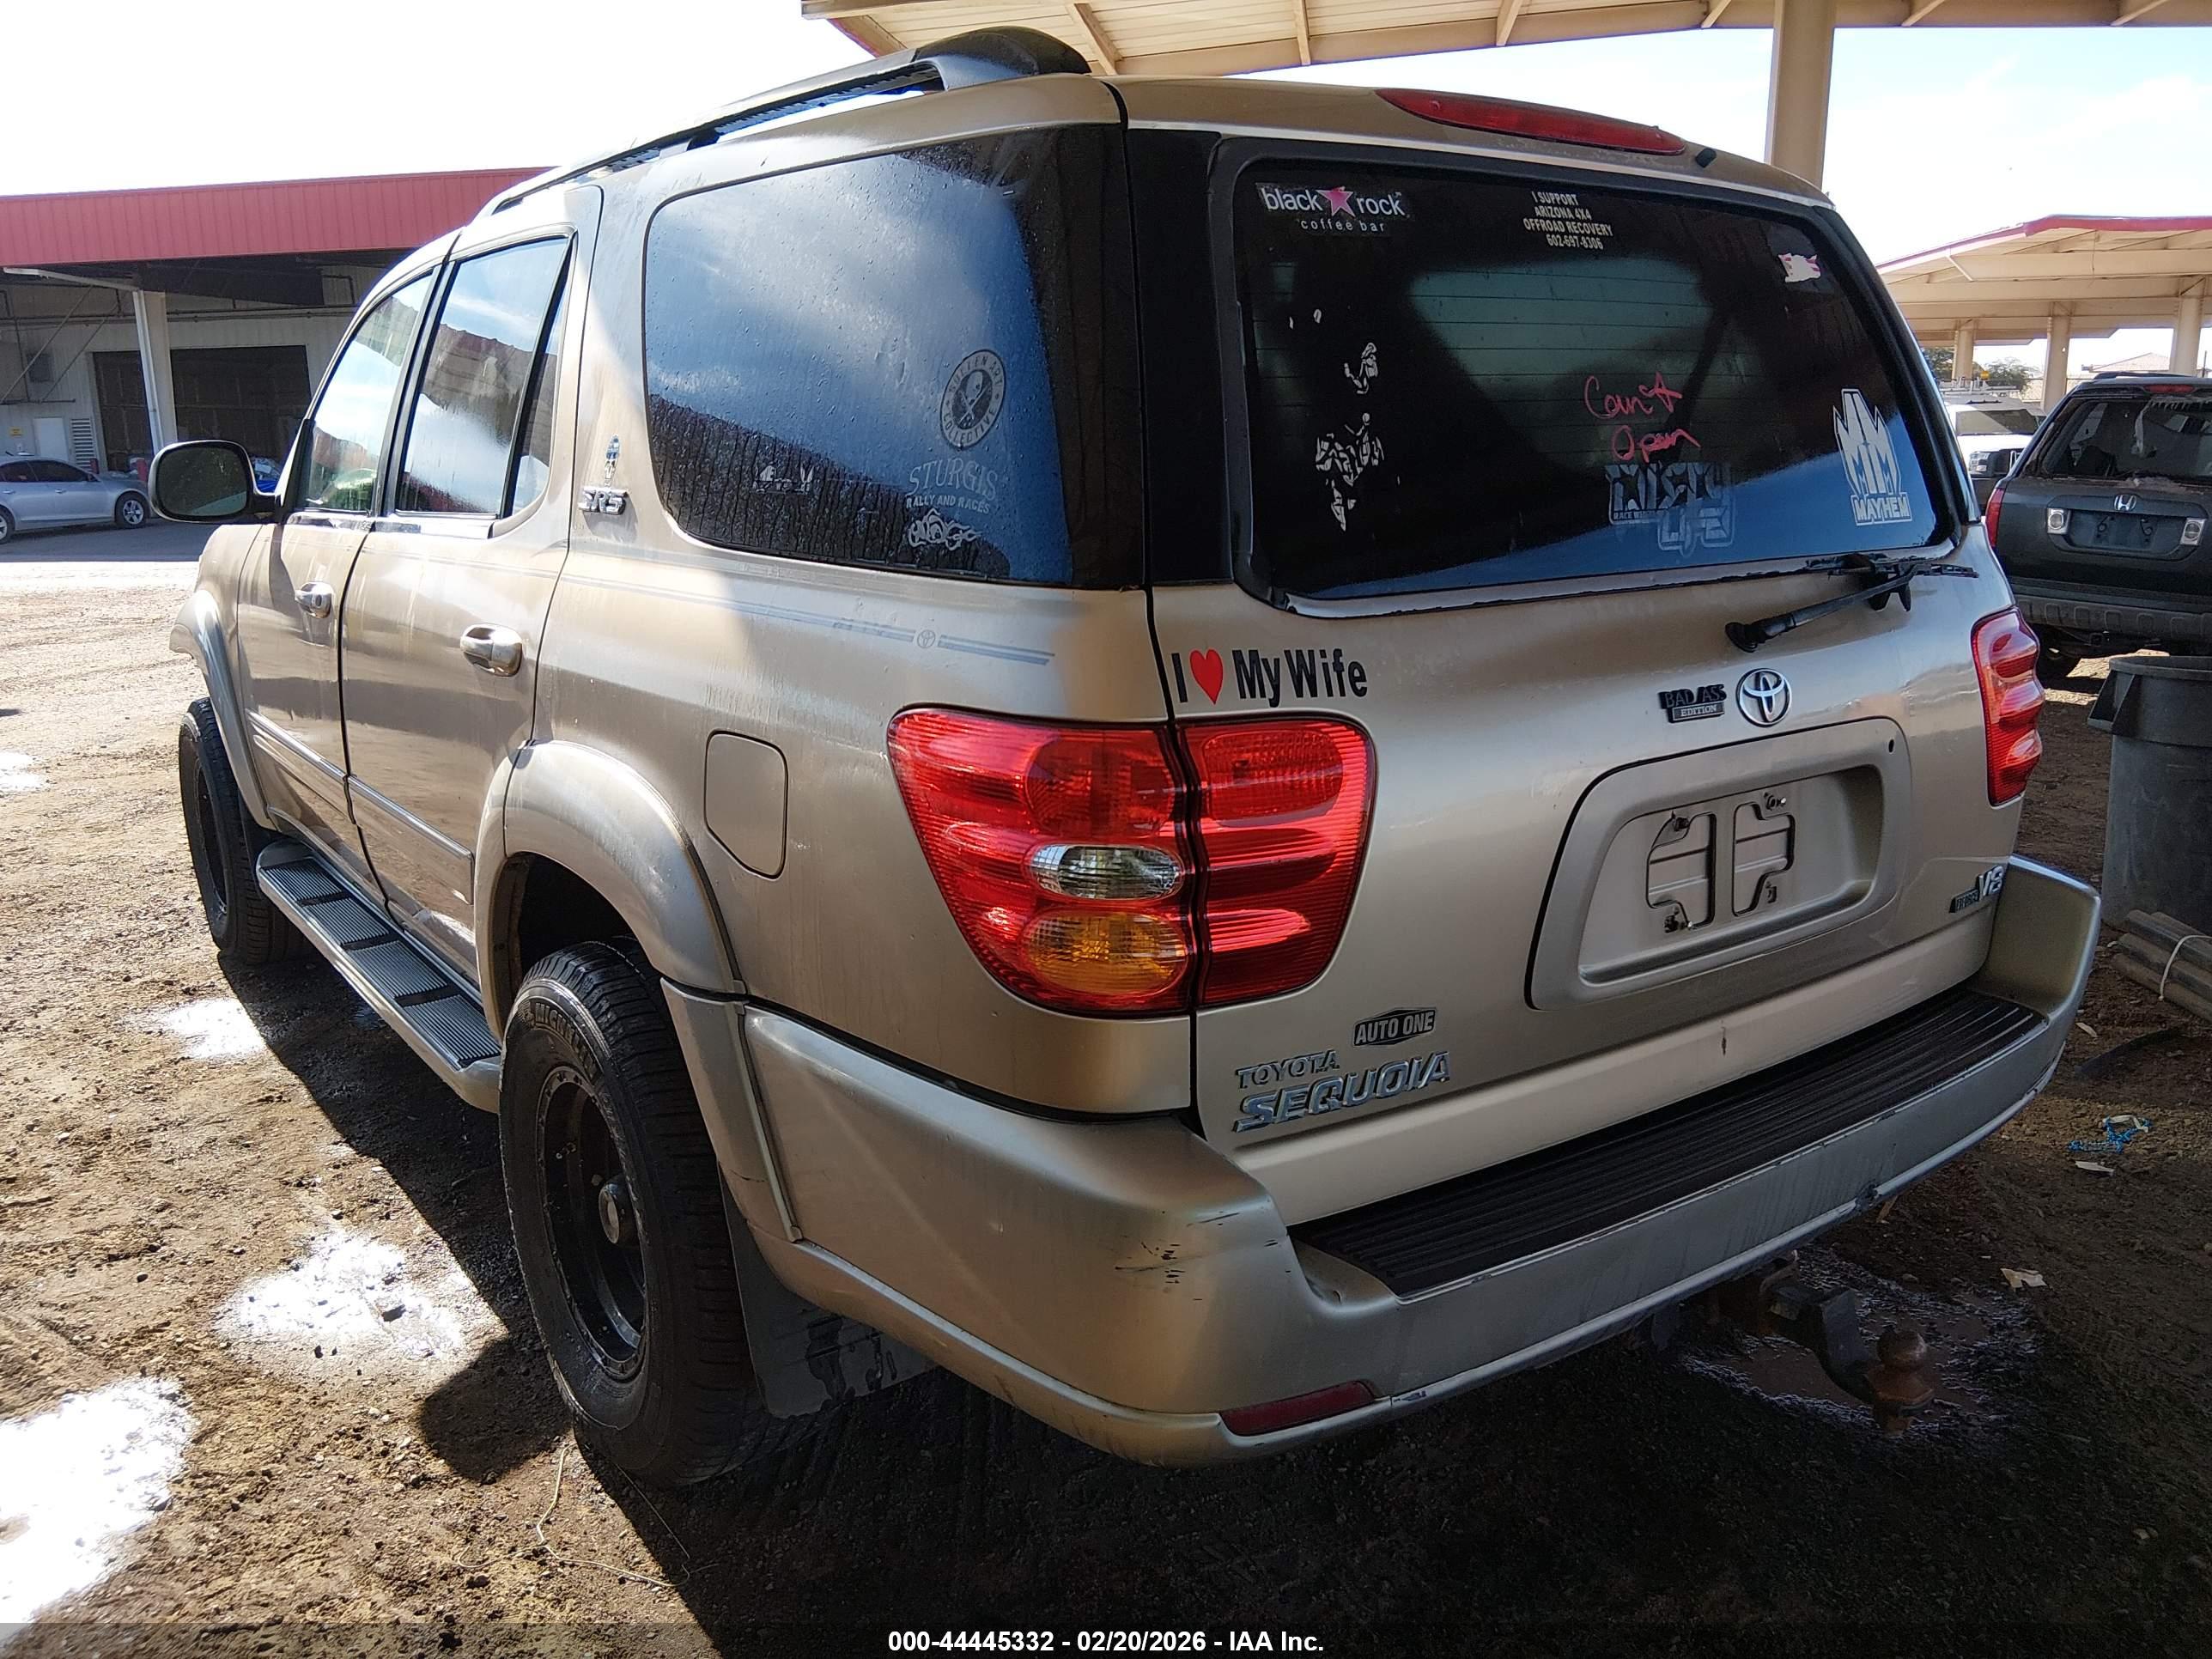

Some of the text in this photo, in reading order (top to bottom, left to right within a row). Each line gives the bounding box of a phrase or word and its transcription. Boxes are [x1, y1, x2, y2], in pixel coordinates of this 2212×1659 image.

[1261, 187, 1405, 216] black rock
[1531, 191, 1579, 206] I SUPPORT
[1534, 205, 1592, 221] ARIZONA 4X4
[1300, 218, 1385, 233] coffee bar
[1522, 217, 1613, 237] OFFROAD RECOVERY
[943, 409, 996, 444] COLLECTIVE
[904, 457, 999, 501] STURGIS
[906, 494, 991, 514] RALLY AND RACES
[1854, 496, 1911, 521] MAYHEM
[1171, 647, 1368, 708] I My Wife
[1680, 704, 1718, 718] EDITION
[1978, 865, 2004, 897] V8
[1355, 1011, 1435, 1045] AUTO ONE
[1237, 1049, 1341, 1090] TOYOTA
[1231, 1051, 1450, 1133] SEQUOIA
